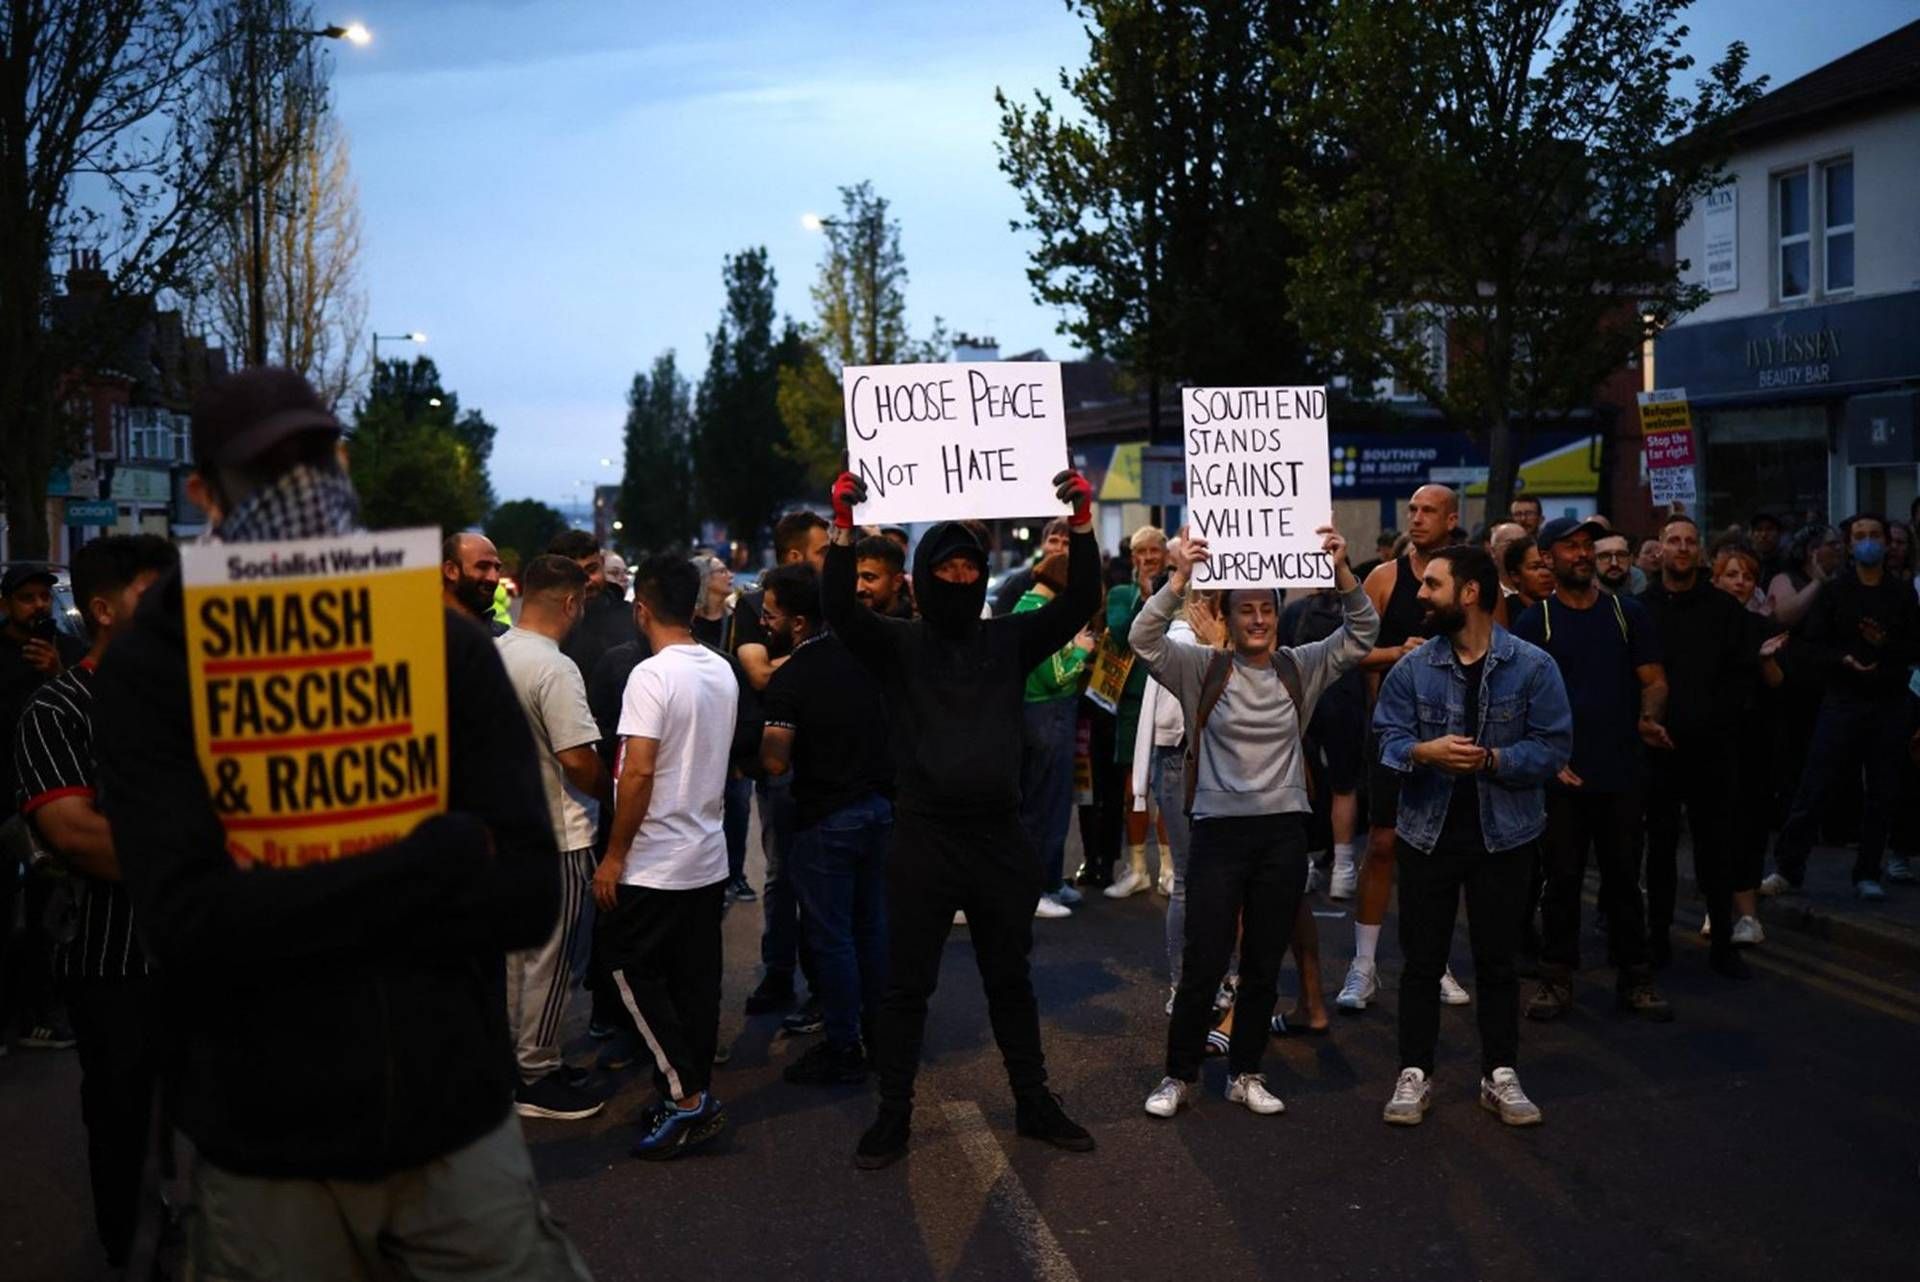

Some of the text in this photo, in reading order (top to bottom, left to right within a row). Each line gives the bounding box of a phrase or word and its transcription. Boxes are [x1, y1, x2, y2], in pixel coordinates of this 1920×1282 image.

[1759, 363, 1830, 388] BEAUTY BAR
[851, 369, 1046, 441] CHOOSE PEACE
[1645, 417, 1686, 429] welcome
[1189, 428, 1281, 456] STANDS
[1362, 448, 1437, 461] SOUTHEND
[1647, 433, 1688, 448] Stop the
[1648, 446, 1689, 460] far right
[859, 443, 1018, 498] NOT HATE
[1190, 461, 1304, 498] AGAINST
[1360, 462, 1376, 473] IN
[1379, 461, 1421, 474] SIGHT
[1193, 507, 1294, 538] WHITE
[228, 546, 405, 580] Socialist Worker
[201, 586, 372, 657] SMASH
[207, 660, 411, 737] FASCISM
[216, 733, 439, 814] & RACISM
